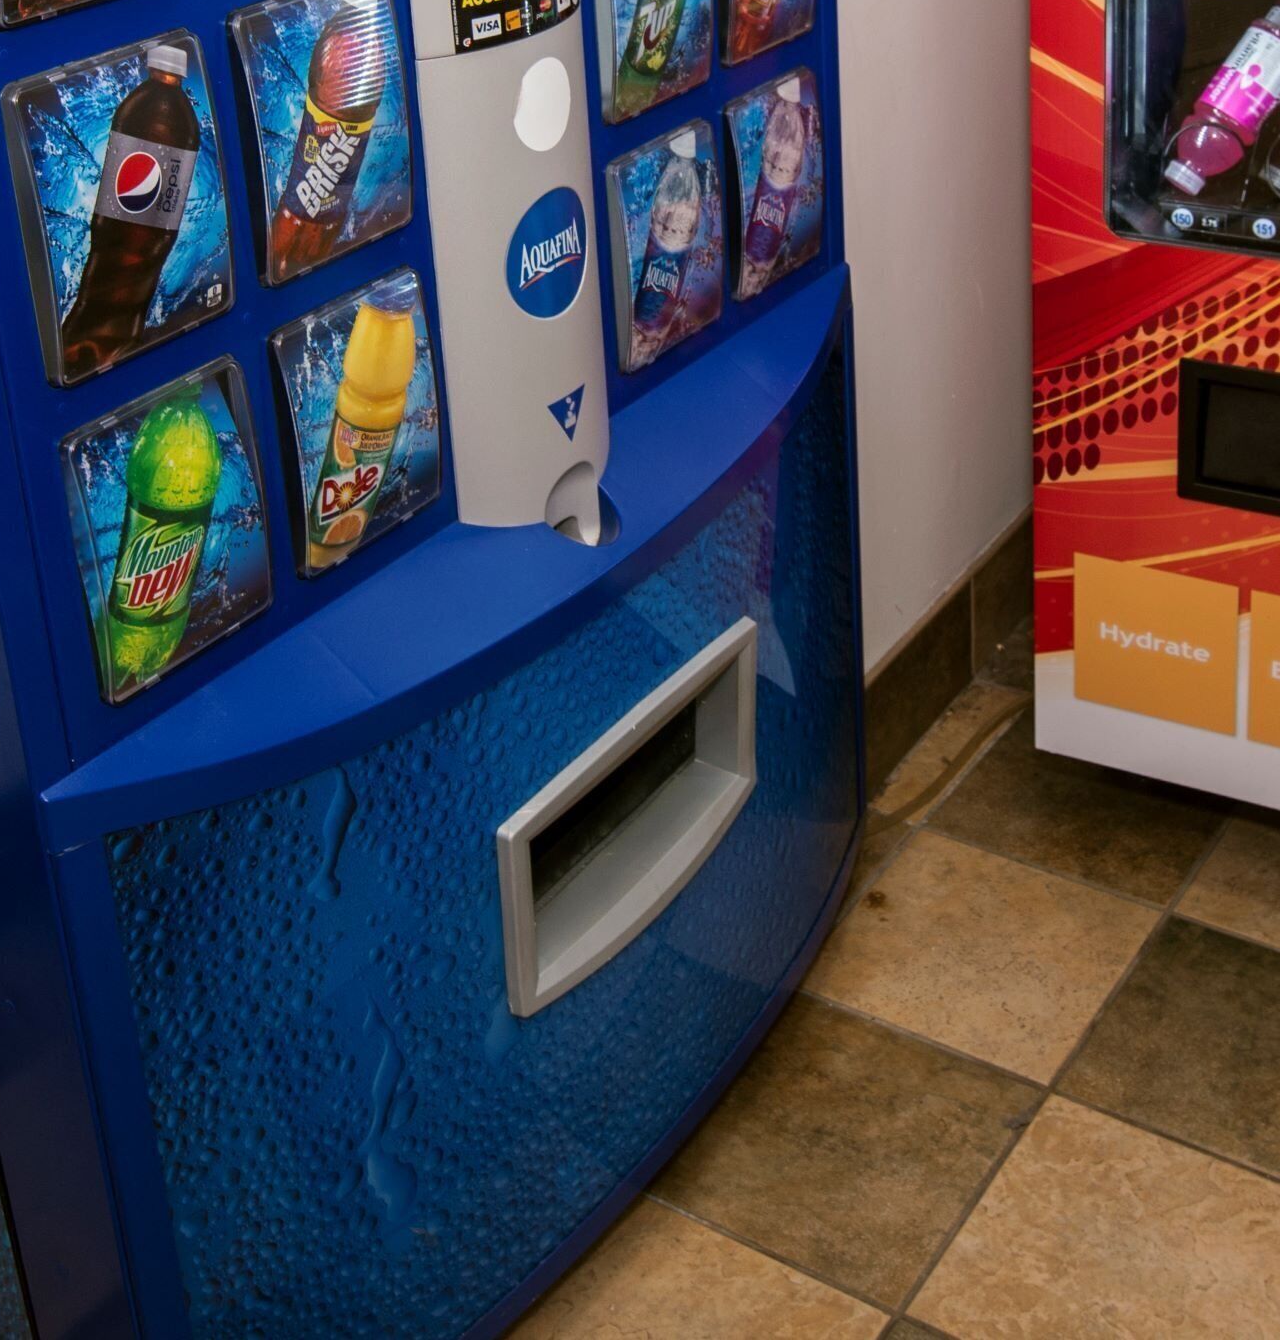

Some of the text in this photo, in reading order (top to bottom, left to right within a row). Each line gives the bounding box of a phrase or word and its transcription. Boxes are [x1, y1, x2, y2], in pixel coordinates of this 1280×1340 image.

[475, 20, 500, 34] VISA
[161, 158, 183, 215] pepsi
[296, 122, 361, 219] BRISK
[1173, 212, 1192, 226] 150
[1254, 222, 1273, 236] 151
[519, 217, 582, 289] AQUAFINA
[320, 465, 380, 516] Dole
[125, 525, 204, 579] Mountain
[1099, 619, 1211, 664] Hydrate
